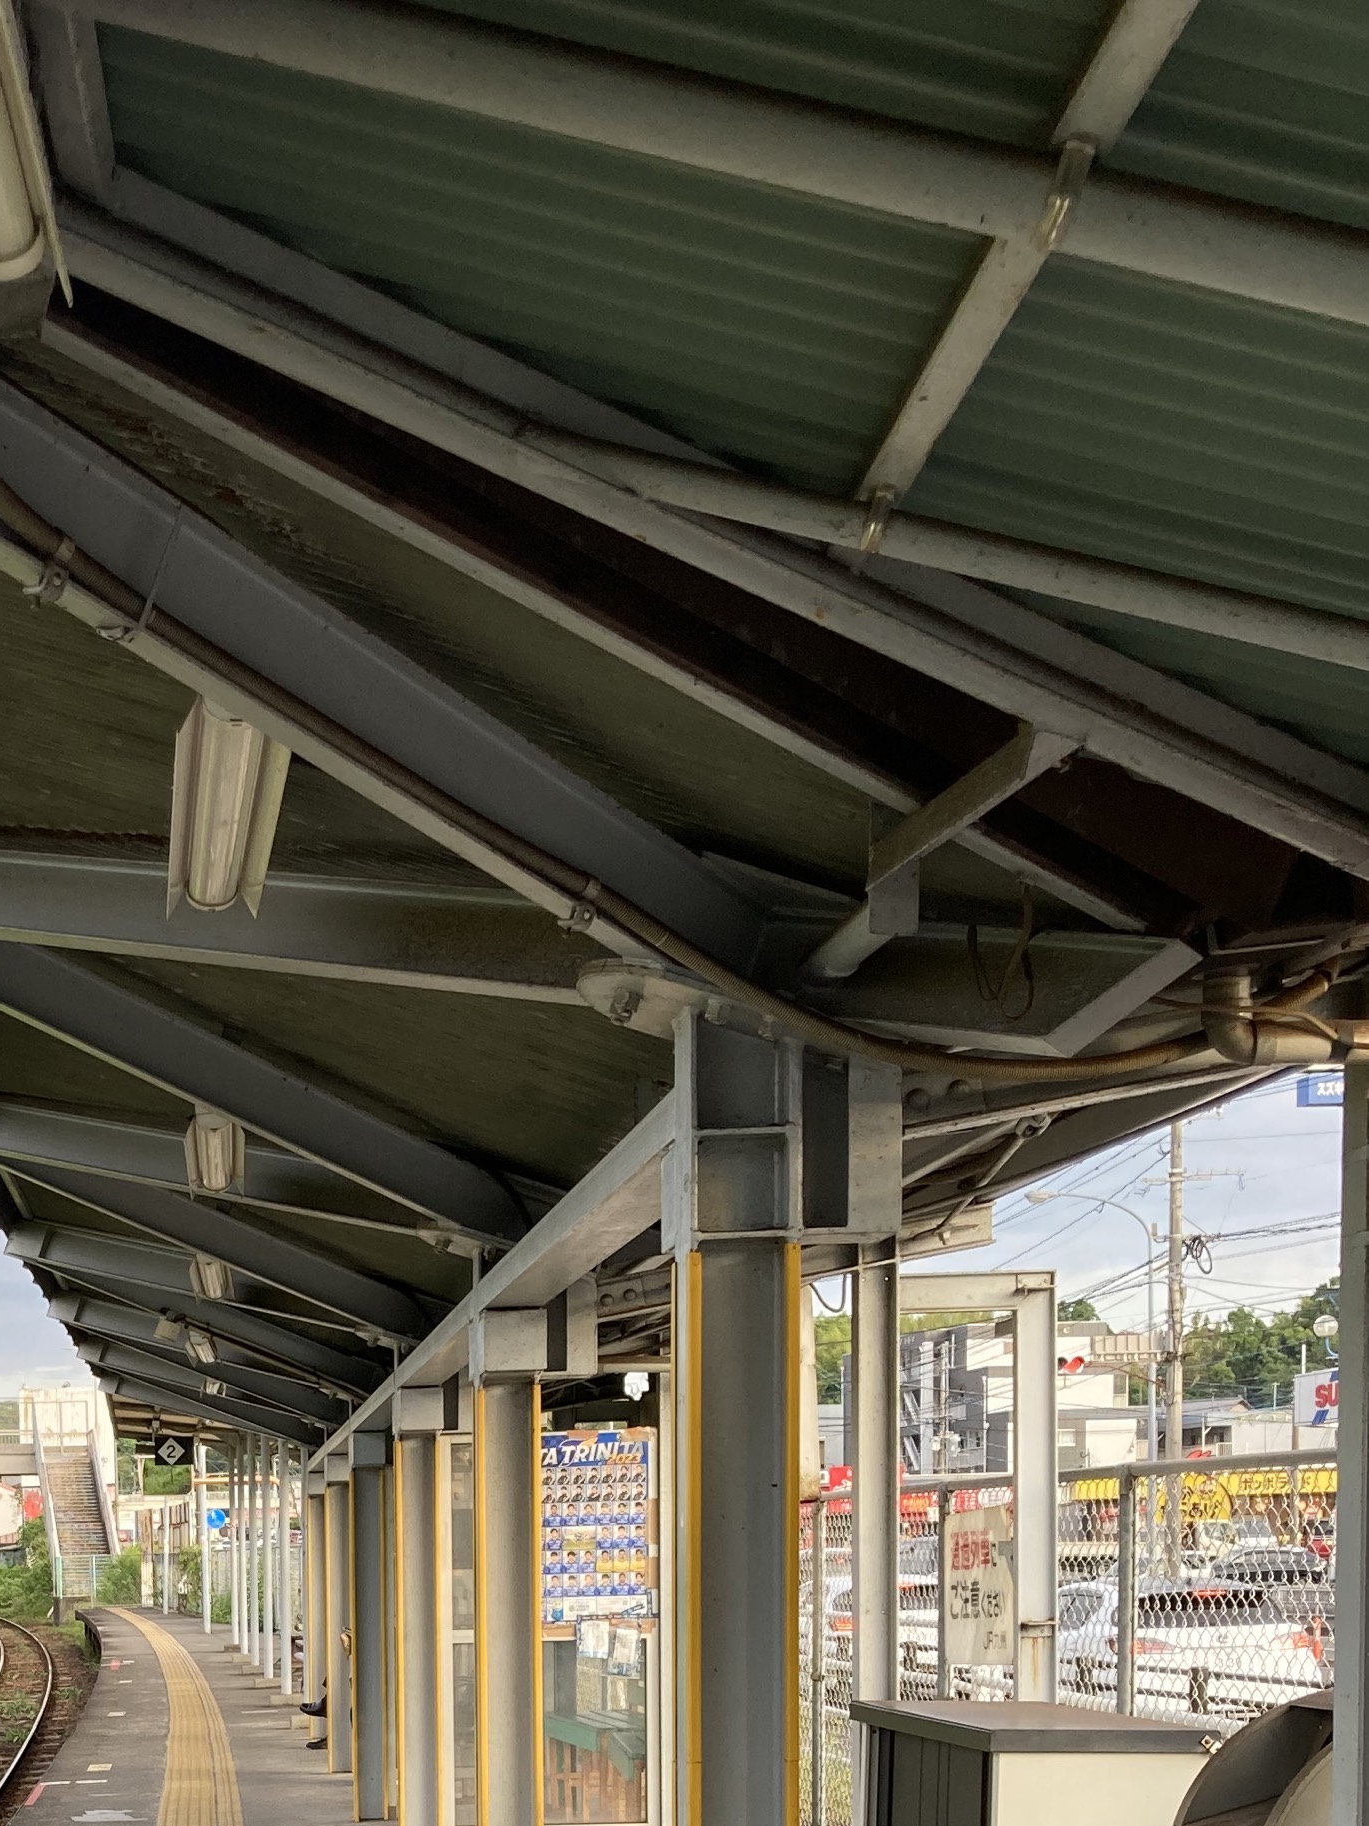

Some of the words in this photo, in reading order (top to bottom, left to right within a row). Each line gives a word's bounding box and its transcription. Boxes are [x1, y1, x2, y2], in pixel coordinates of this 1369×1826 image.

[1315, 1383, 1339, 1408] SU
[166, 1445, 176, 1458] 2
[561, 1441, 645, 1464] TRINITA
[607, 1453, 642, 1465] 2023
[950, 1578, 1006, 1620] ご注意ください
